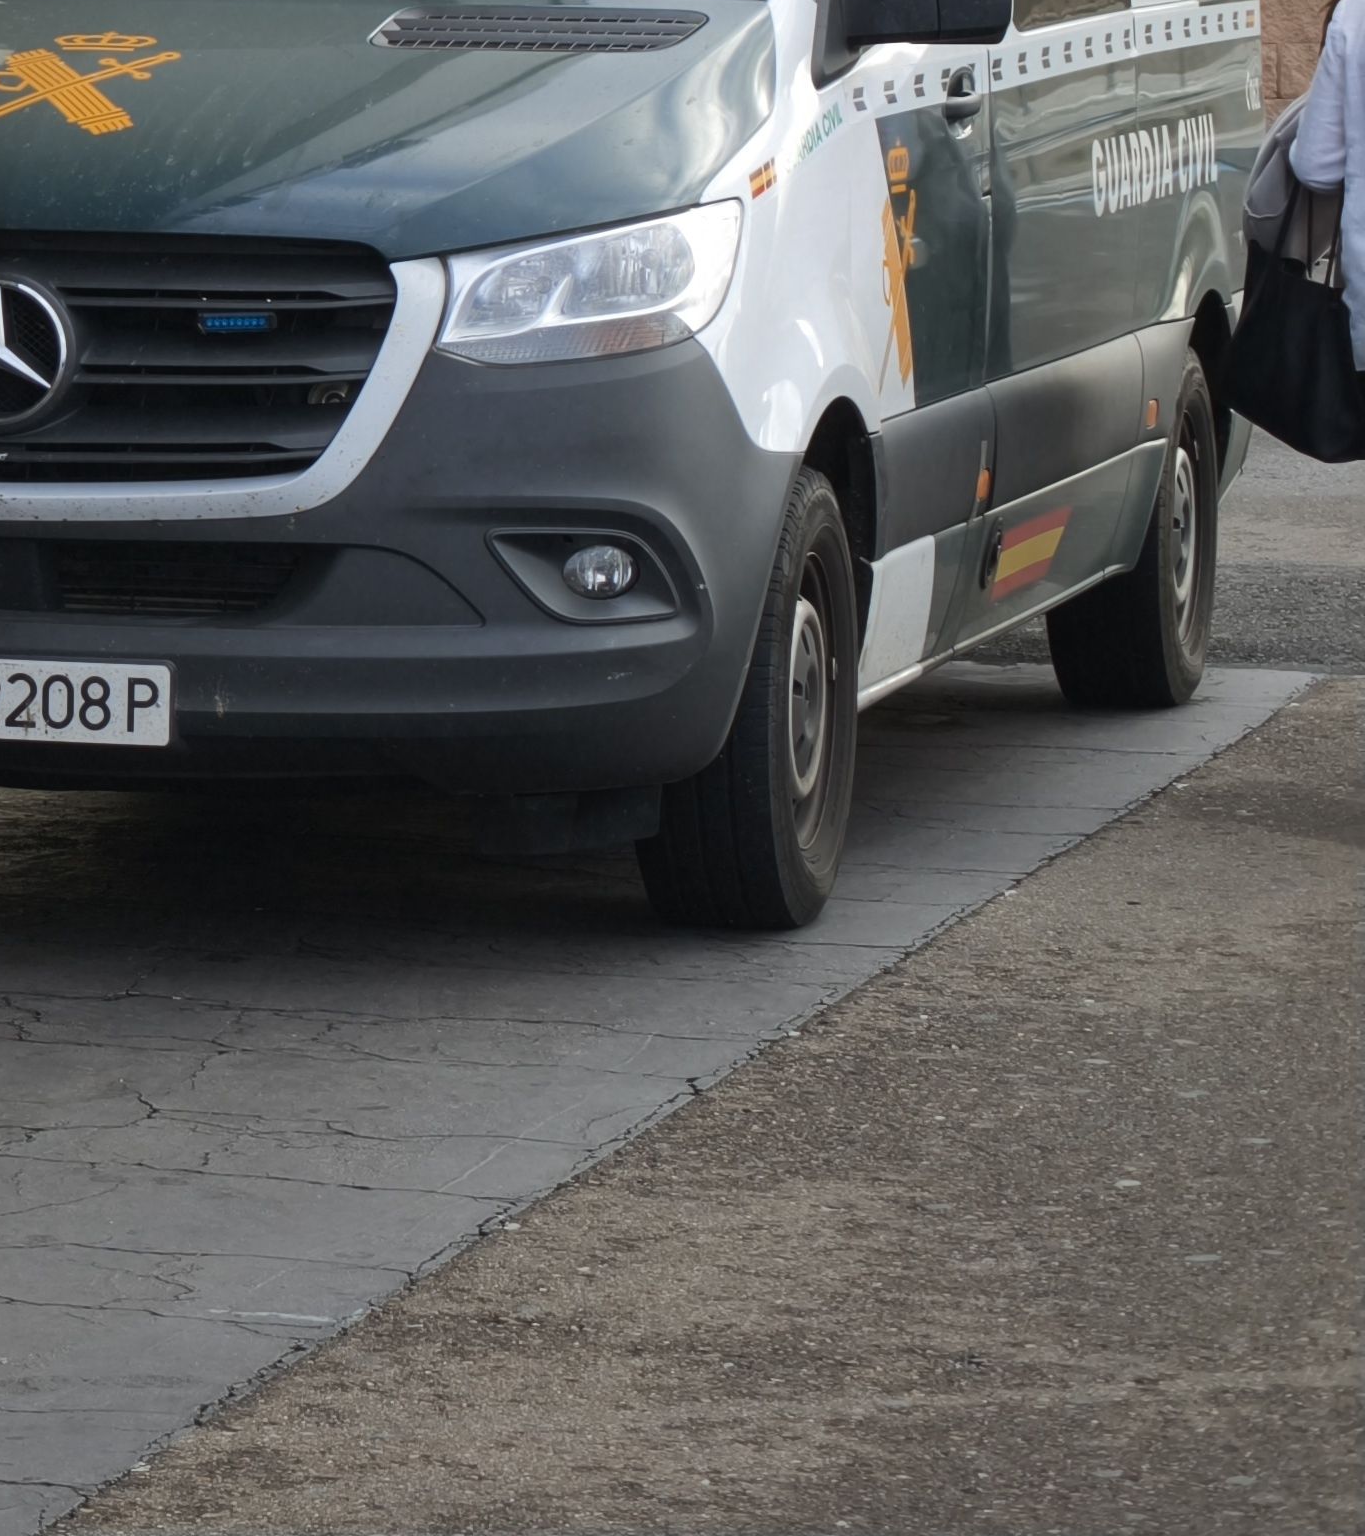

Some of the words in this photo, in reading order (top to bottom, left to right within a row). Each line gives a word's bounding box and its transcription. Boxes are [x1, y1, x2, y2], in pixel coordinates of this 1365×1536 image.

[1091, 124, 1174, 218] GUARDIA
[1177, 112, 1218, 193] CIVIL
[126, 676, 160, 733] P
